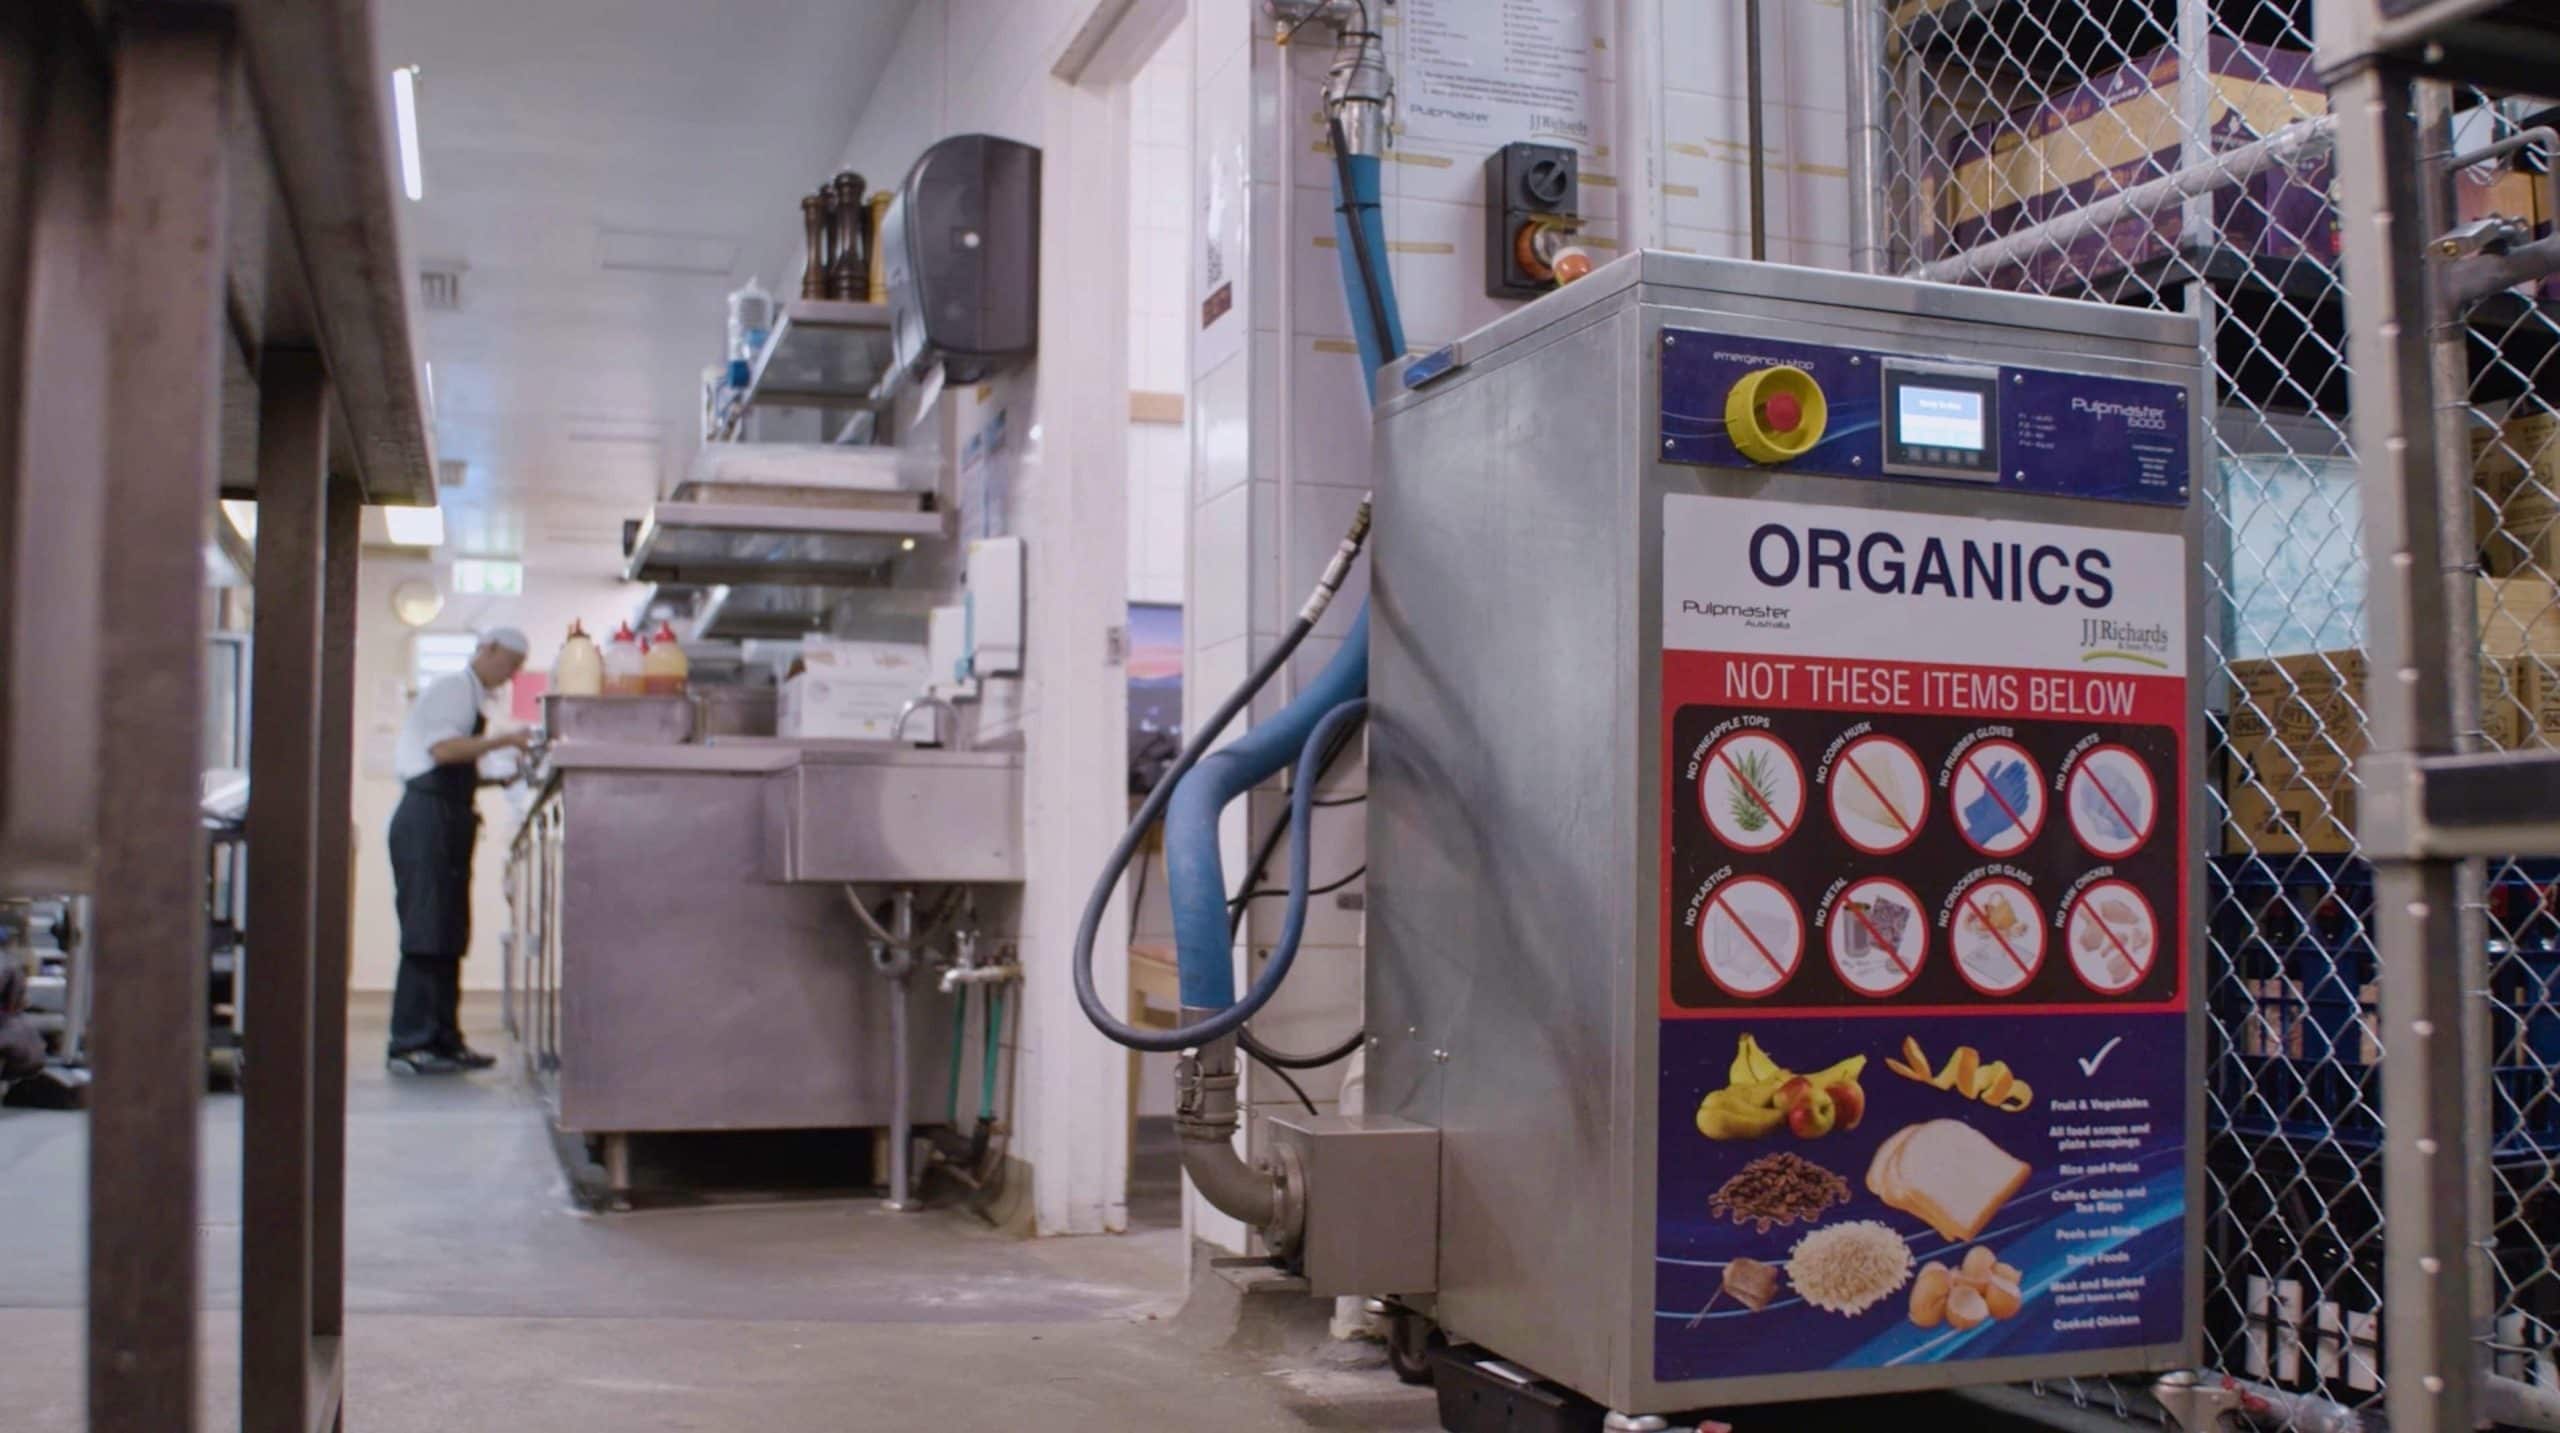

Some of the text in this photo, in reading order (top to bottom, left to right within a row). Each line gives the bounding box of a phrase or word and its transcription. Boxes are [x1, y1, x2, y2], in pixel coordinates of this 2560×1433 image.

[1713, 351, 1784, 366] emergency
[2071, 396, 2165, 421] Pulpmaster
[1749, 523, 2113, 608] ORGANICS
[1682, 599, 1791, 618] Pulpmaster
[1725, 660, 2136, 716] NOT THESE ITEMS BELOW
[1686, 715, 1771, 780] NO PINEAPPLE TOPS
[1816, 720, 1872, 784] NO CORN HUSK
[1938, 725, 2014, 787] NO RUBBER GLOVES
[2060, 748, 2079, 774] HAIR
[2054, 773, 2067, 792] NO
[1684, 865, 1732, 927] NO PLASTICS
[1815, 877, 1848, 927] NO METAL
[1937, 864, 2033, 928] NO CROCKERY OR GLASS
[2055, 866, 2114, 928] NO RAW CHICKEN
[2050, 1097, 2149, 1111] Fruit & Vegetables
[2048, 1121, 2151, 1138] All food scraps and
[2058, 1137, 2141, 1152] plate scrapings
[2059, 1161, 2140, 1176] Rice and Pasta
[2051, 1189, 2087, 1202] Coffee
[2126, 1185, 2147, 1198] and
[2074, 1201, 2124, 1214] Tea Bags
[2055, 1227, 2087, 1240] Peels
[2088, 1225, 2109, 1238] and
[2096, 1252, 2131, 1264] Foods
[2079, 1278, 2100, 1290] and
[2101, 1275, 2146, 1288] Seafood
[2053, 1314, 2141, 1331] Cooked Chicken
